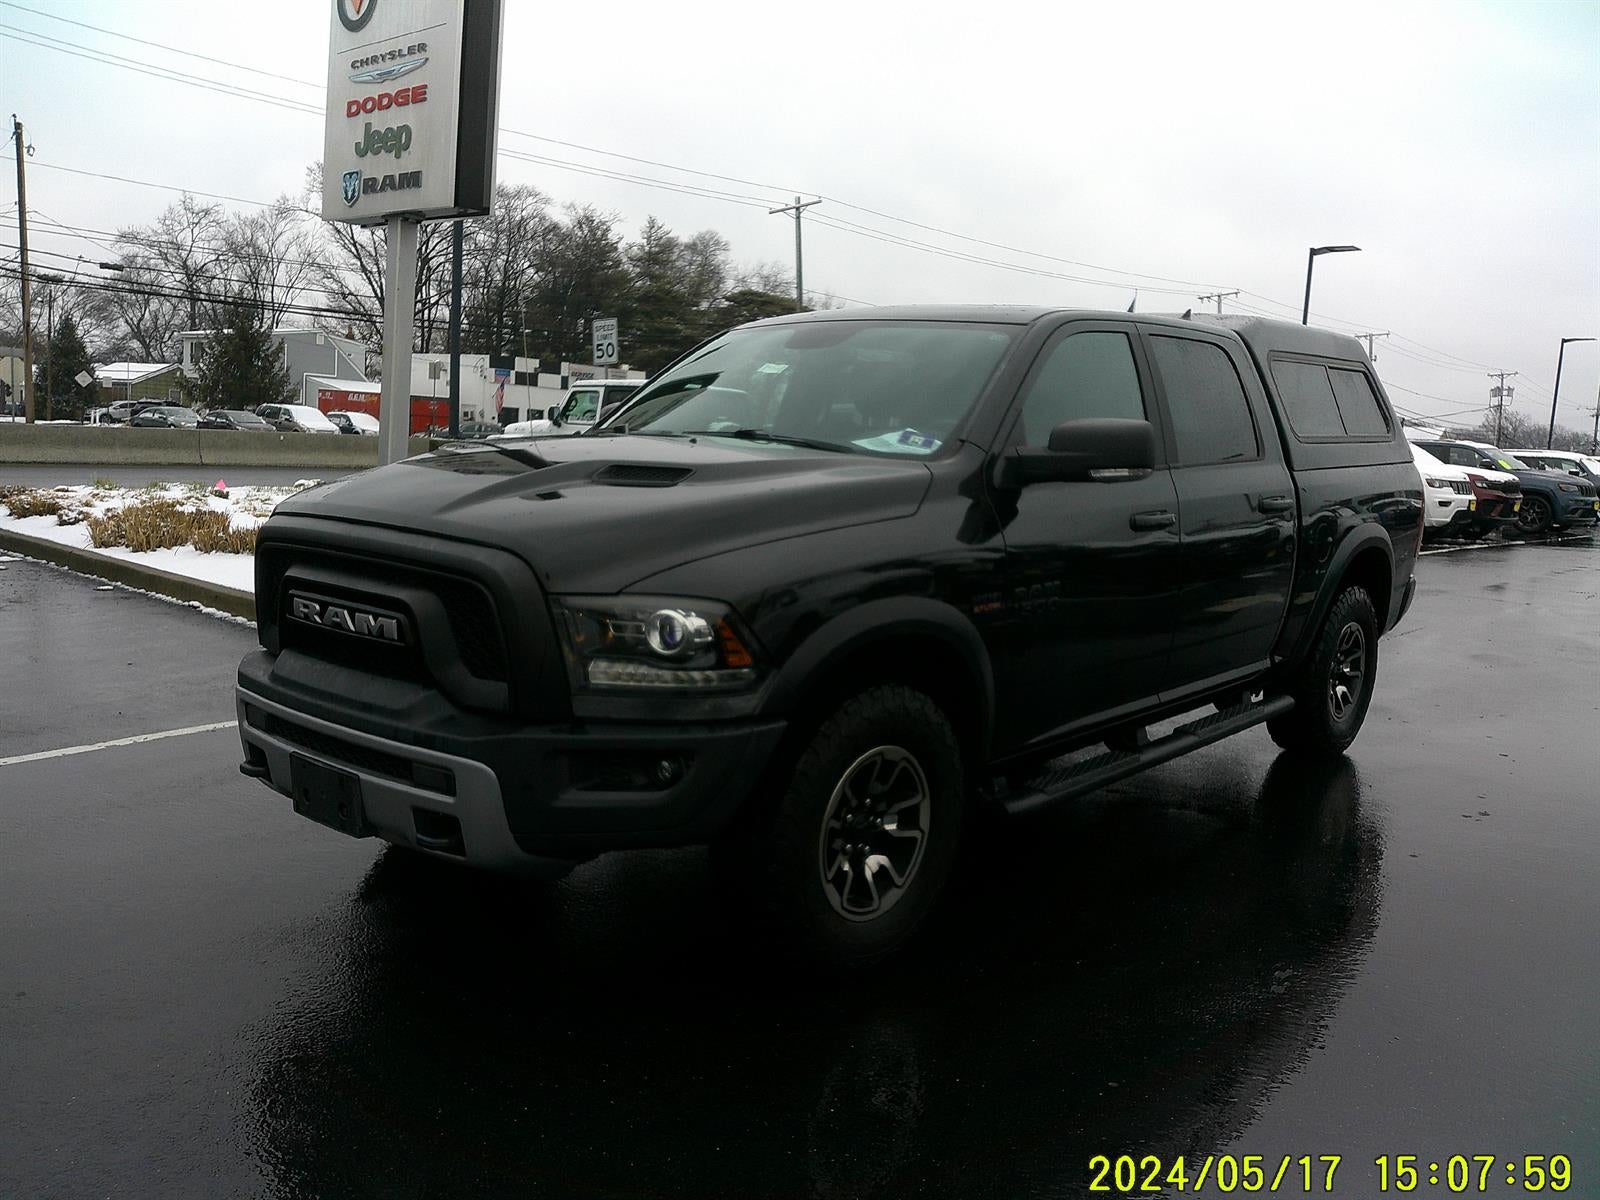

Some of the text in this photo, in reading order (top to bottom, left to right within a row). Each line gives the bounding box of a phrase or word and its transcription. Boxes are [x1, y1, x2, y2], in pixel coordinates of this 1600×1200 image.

[351, 43, 427, 69] CHRYSLER
[346, 84, 428, 117] DODGE
[354, 122, 412, 160] Jeep
[362, 170, 423, 195] RAM
[597, 342, 614, 359] 50
[293, 597, 398, 641] RAM
